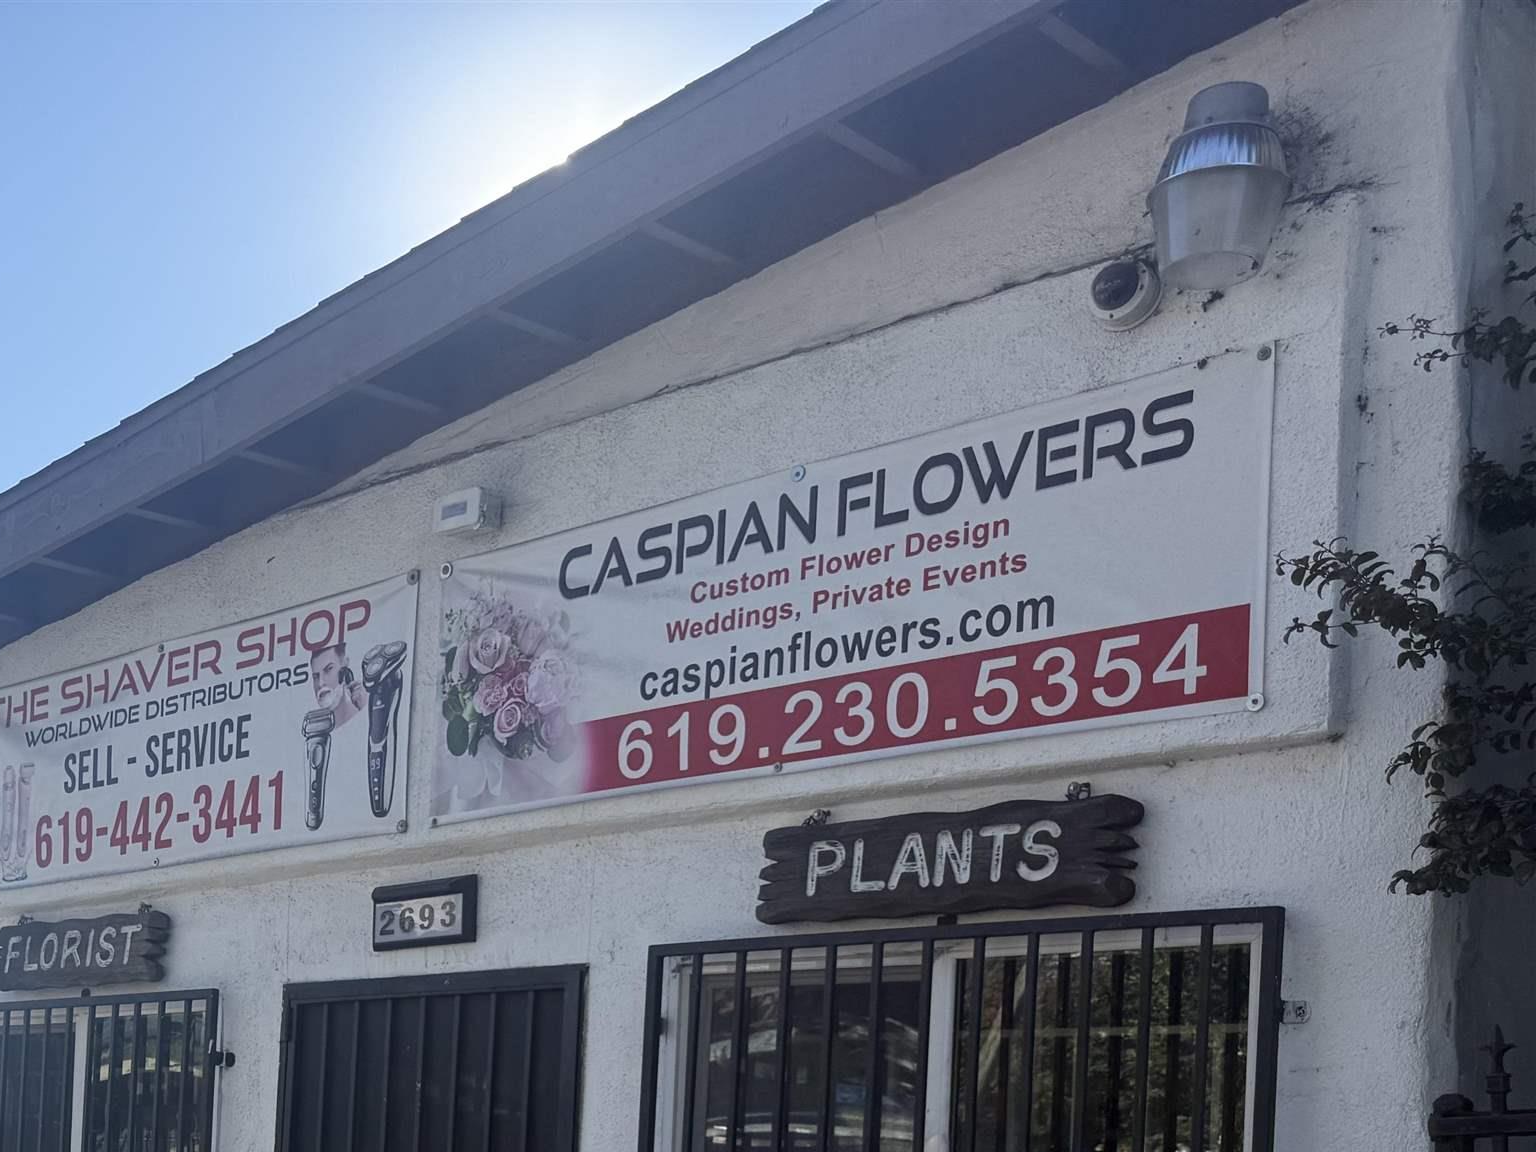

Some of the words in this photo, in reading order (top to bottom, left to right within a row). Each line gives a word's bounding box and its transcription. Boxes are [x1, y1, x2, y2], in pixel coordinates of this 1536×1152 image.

[558, 484, 819, 600] CASPIAN
[836, 388, 1195, 537] FLOWERS
[665, 601, 801, 644] Weddings,
[811, 576, 912, 615] Private
[921, 552, 1028, 593] Events
[690, 566, 790, 604] Custom
[799, 541, 896, 581] Flower
[904, 517, 1011, 558] Design
[59, 638, 223, 715] SHAVER
[235, 598, 371, 671] SHOP
[639, 594, 1055, 701] caspianflowers.com
[24, 703, 141, 749] WORLDWIDE
[145, 662, 310, 721] DISTRIBUTORS
[616, 623, 1208, 780] 619.230.5354
[63, 744, 119, 794] SELL
[127, 756, 137, 765] -
[144, 713, 252, 778] SERVICE
[35, 769, 284, 869] 619-442-3441
[805, 820, 1062, 897] PLANTS
[3, 923, 143, 974] FLORIST
[378, 901, 457, 937] 2693
